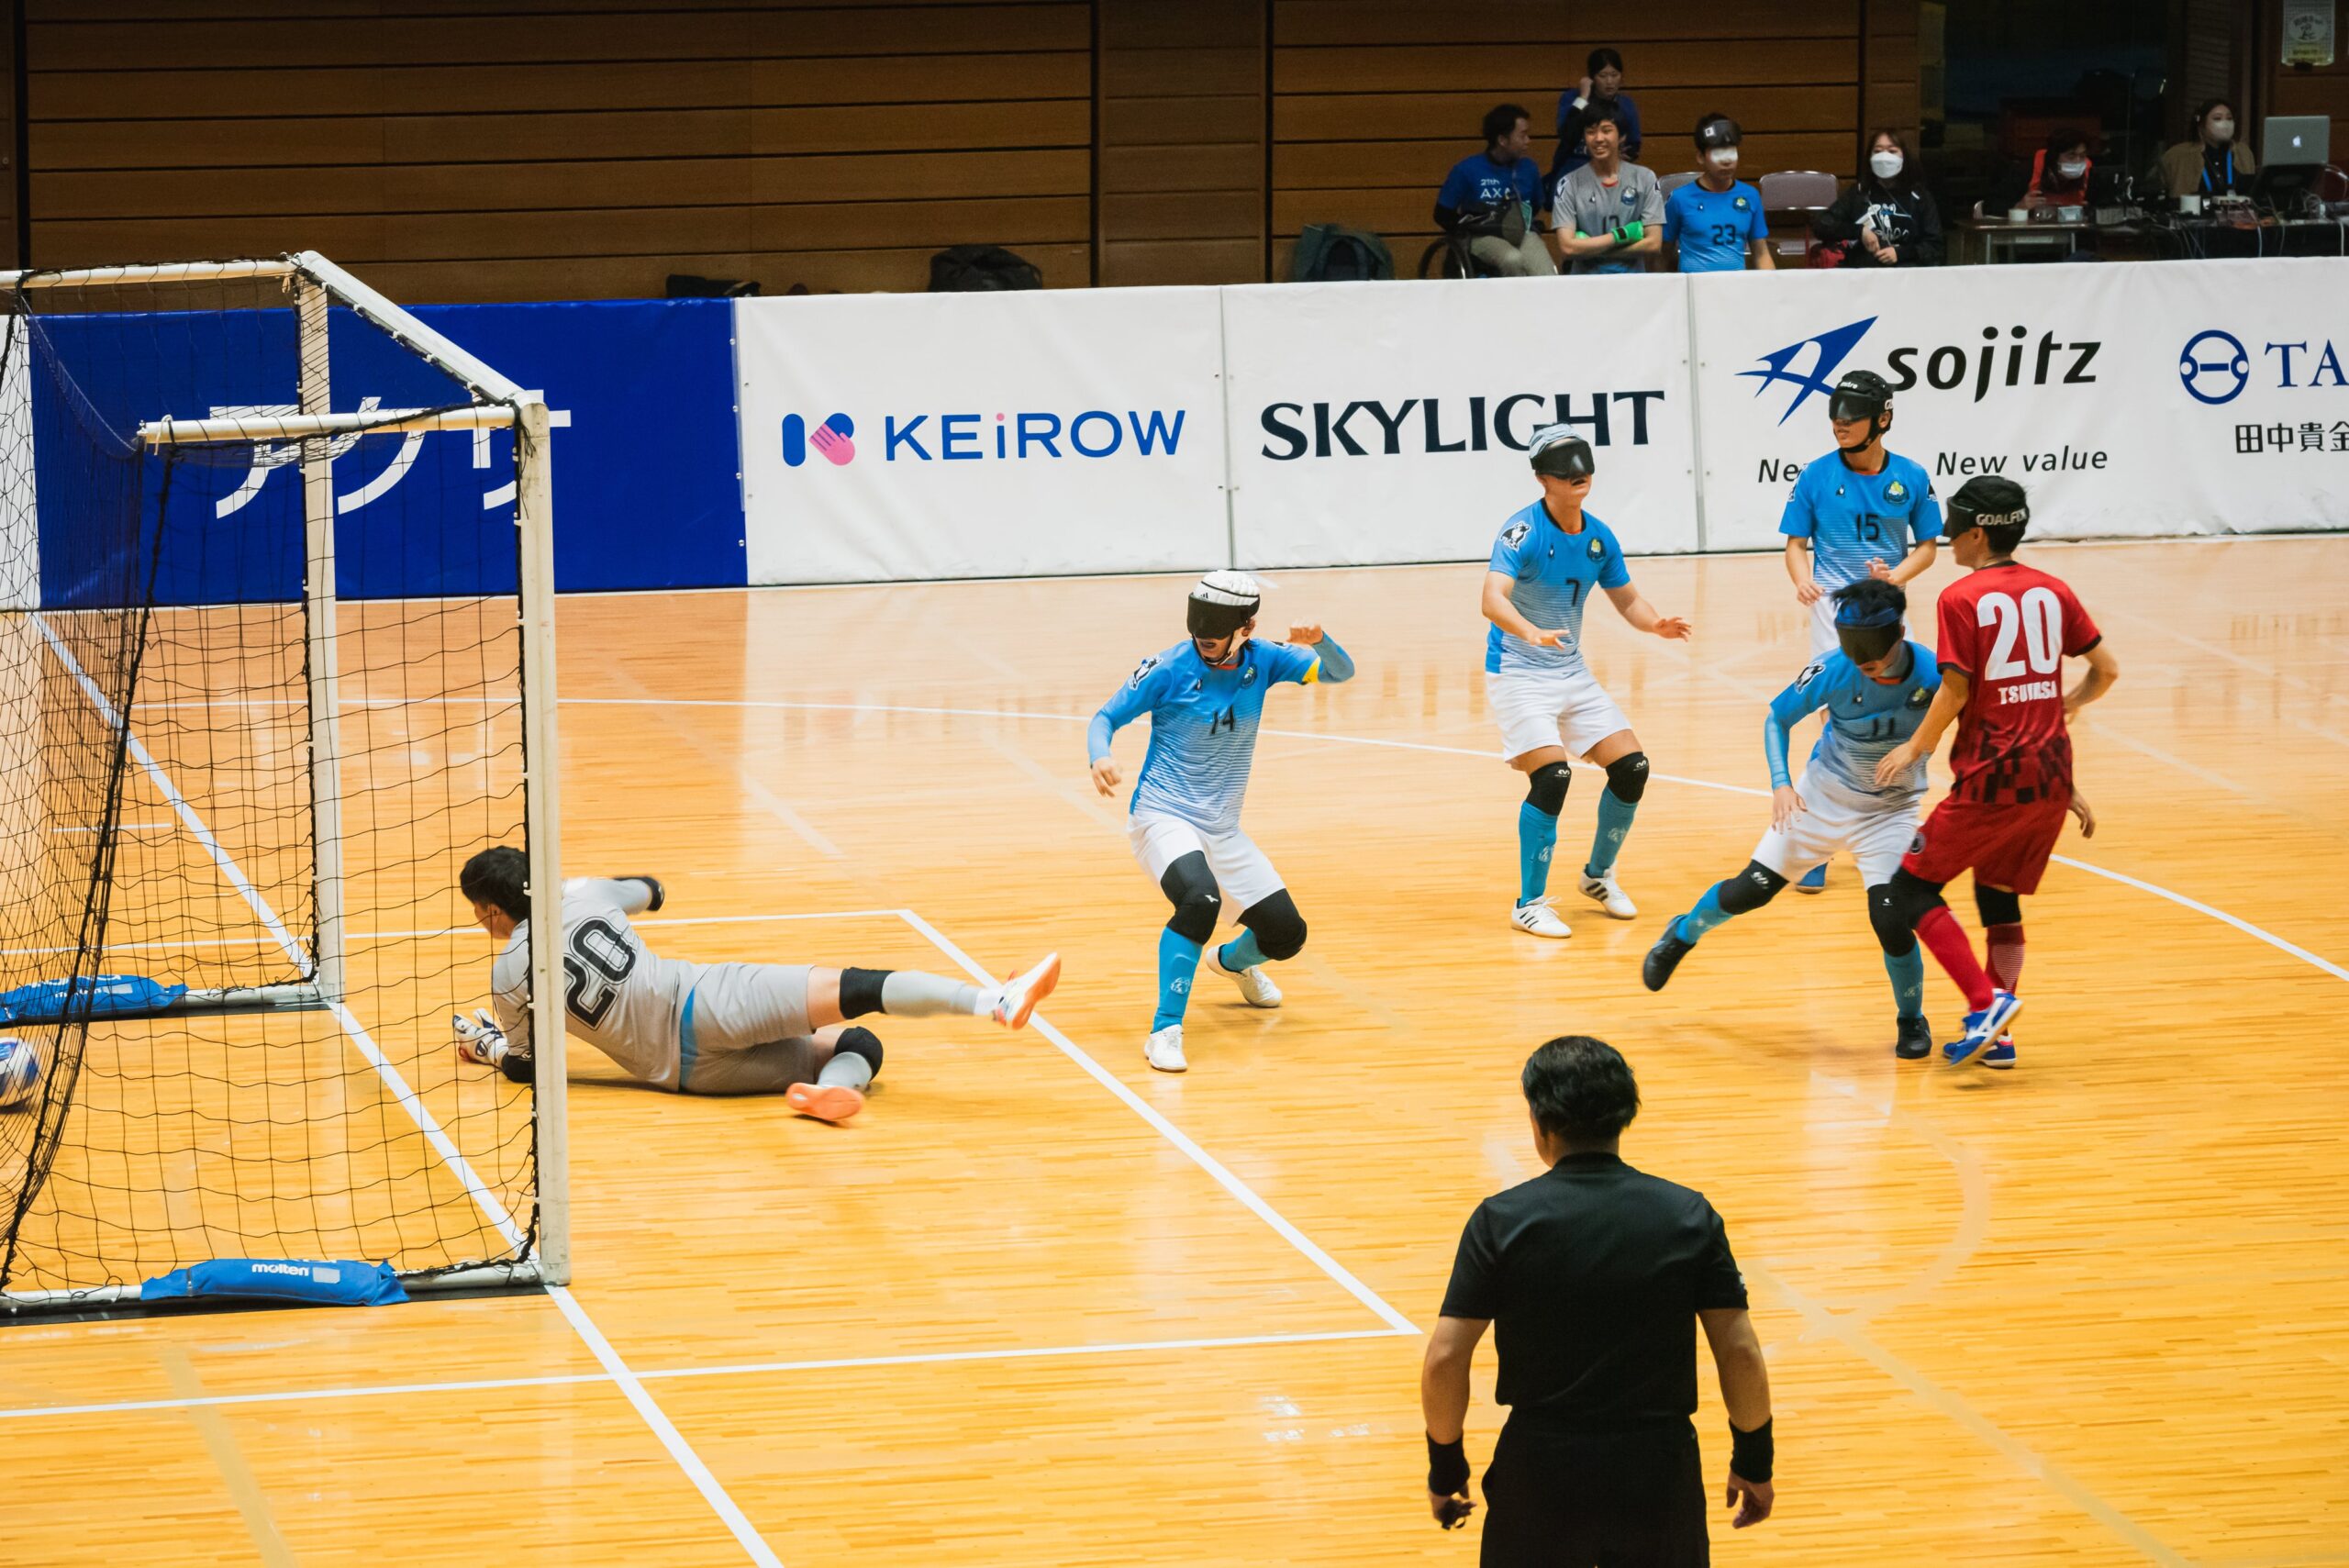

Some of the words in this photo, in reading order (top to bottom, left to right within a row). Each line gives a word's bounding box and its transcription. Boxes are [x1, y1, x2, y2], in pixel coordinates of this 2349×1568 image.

[1712, 224, 1736, 246] 23
[1887, 325, 2101, 404] sojitz
[2265, 339, 2349, 388] TA
[1260, 390, 1665, 461] SKYLIGHT
[2235, 420, 2349, 453] 田中貴金
[1758, 459, 1808, 483] Ne
[1936, 451, 2008, 475] New
[2022, 445, 2109, 472] value
[1855, 514, 1881, 541] 15
[1565, 579, 1581, 607] 7
[1976, 586, 2064, 681] 20
[1209, 705, 1236, 736] 14
[1873, 717, 1895, 740] 11
[563, 916, 637, 1031] 20
[251, 1263, 309, 1276] molten
